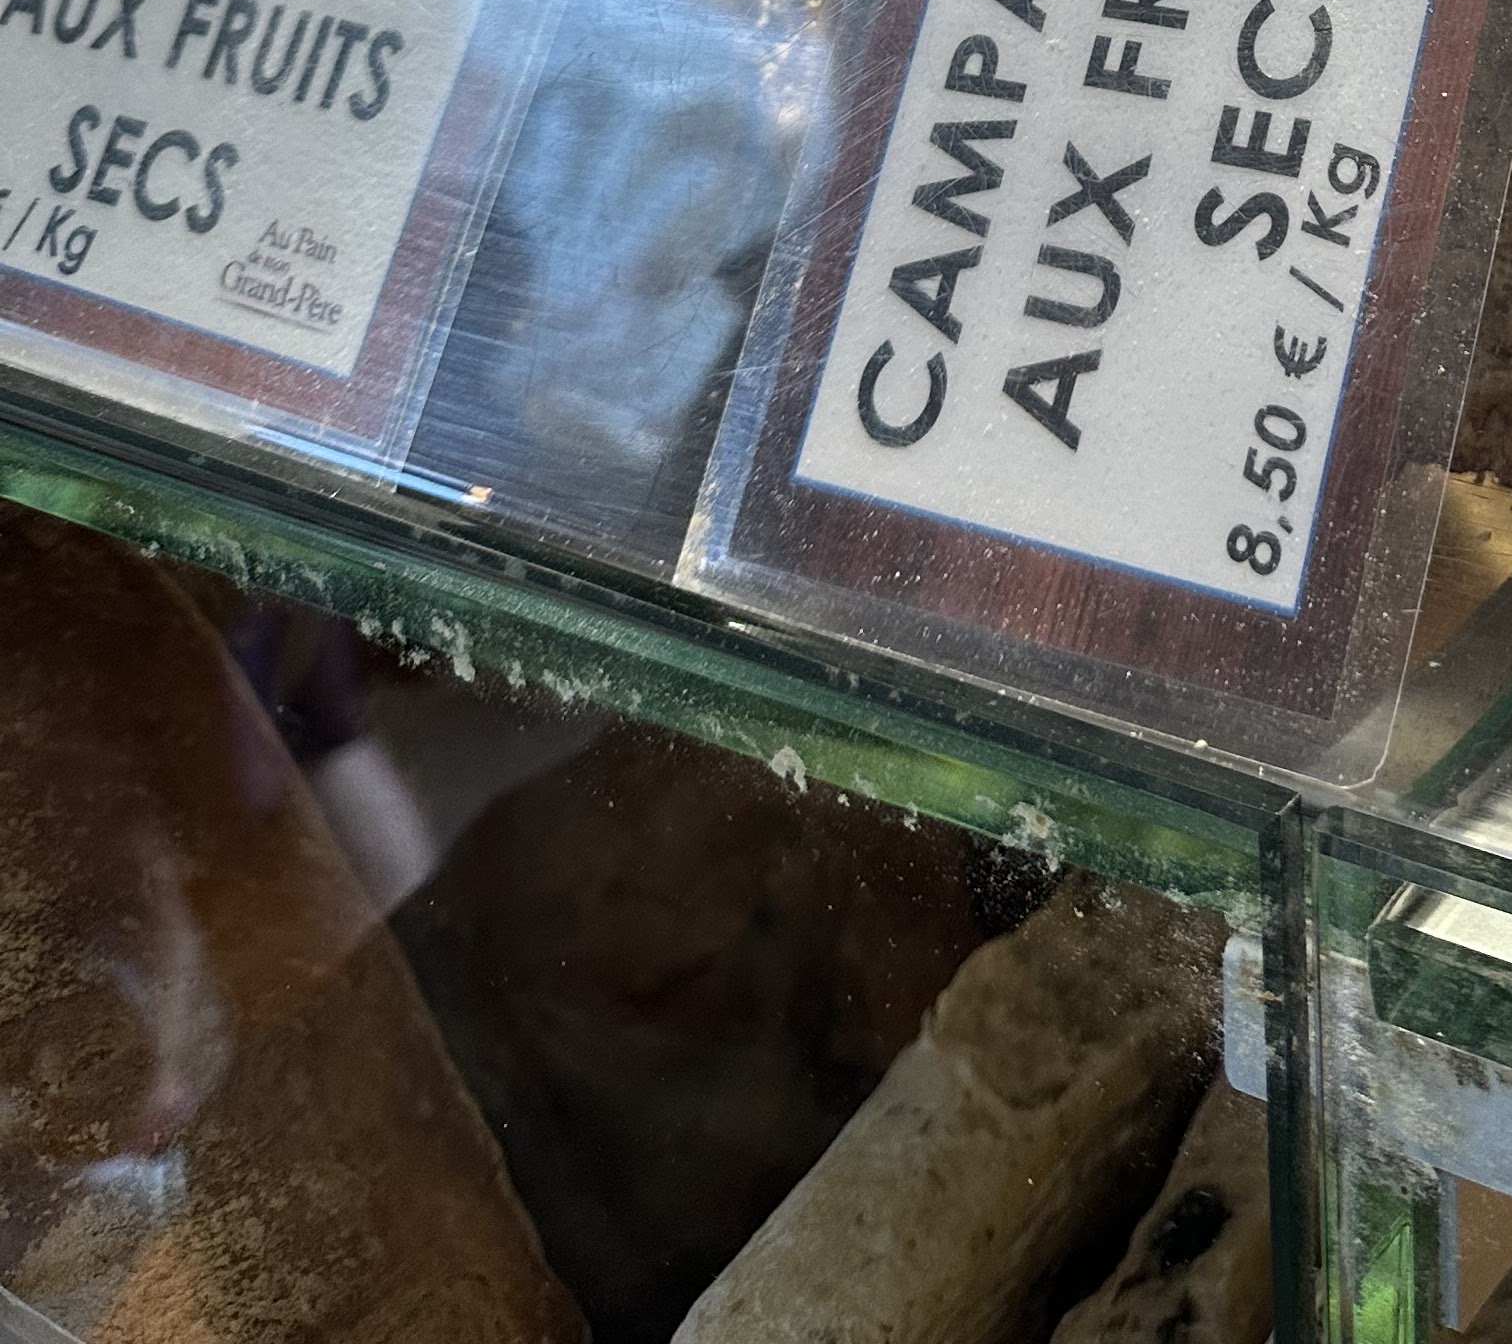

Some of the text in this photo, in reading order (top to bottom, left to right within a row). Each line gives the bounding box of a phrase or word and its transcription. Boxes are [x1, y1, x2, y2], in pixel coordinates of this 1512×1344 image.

[50, 104, 240, 234] SECS
[35, 205, 99, 275] Kg
[258, 219, 338, 264] Au Pain
[221, 261, 342, 324] Grand-Père
[1002, 140, 1153, 453] AUX
[1226, 404, 1307, 575] 8,50
[1273, 324, 1328, 379] €
[1301, 142, 1381, 247] Kg
